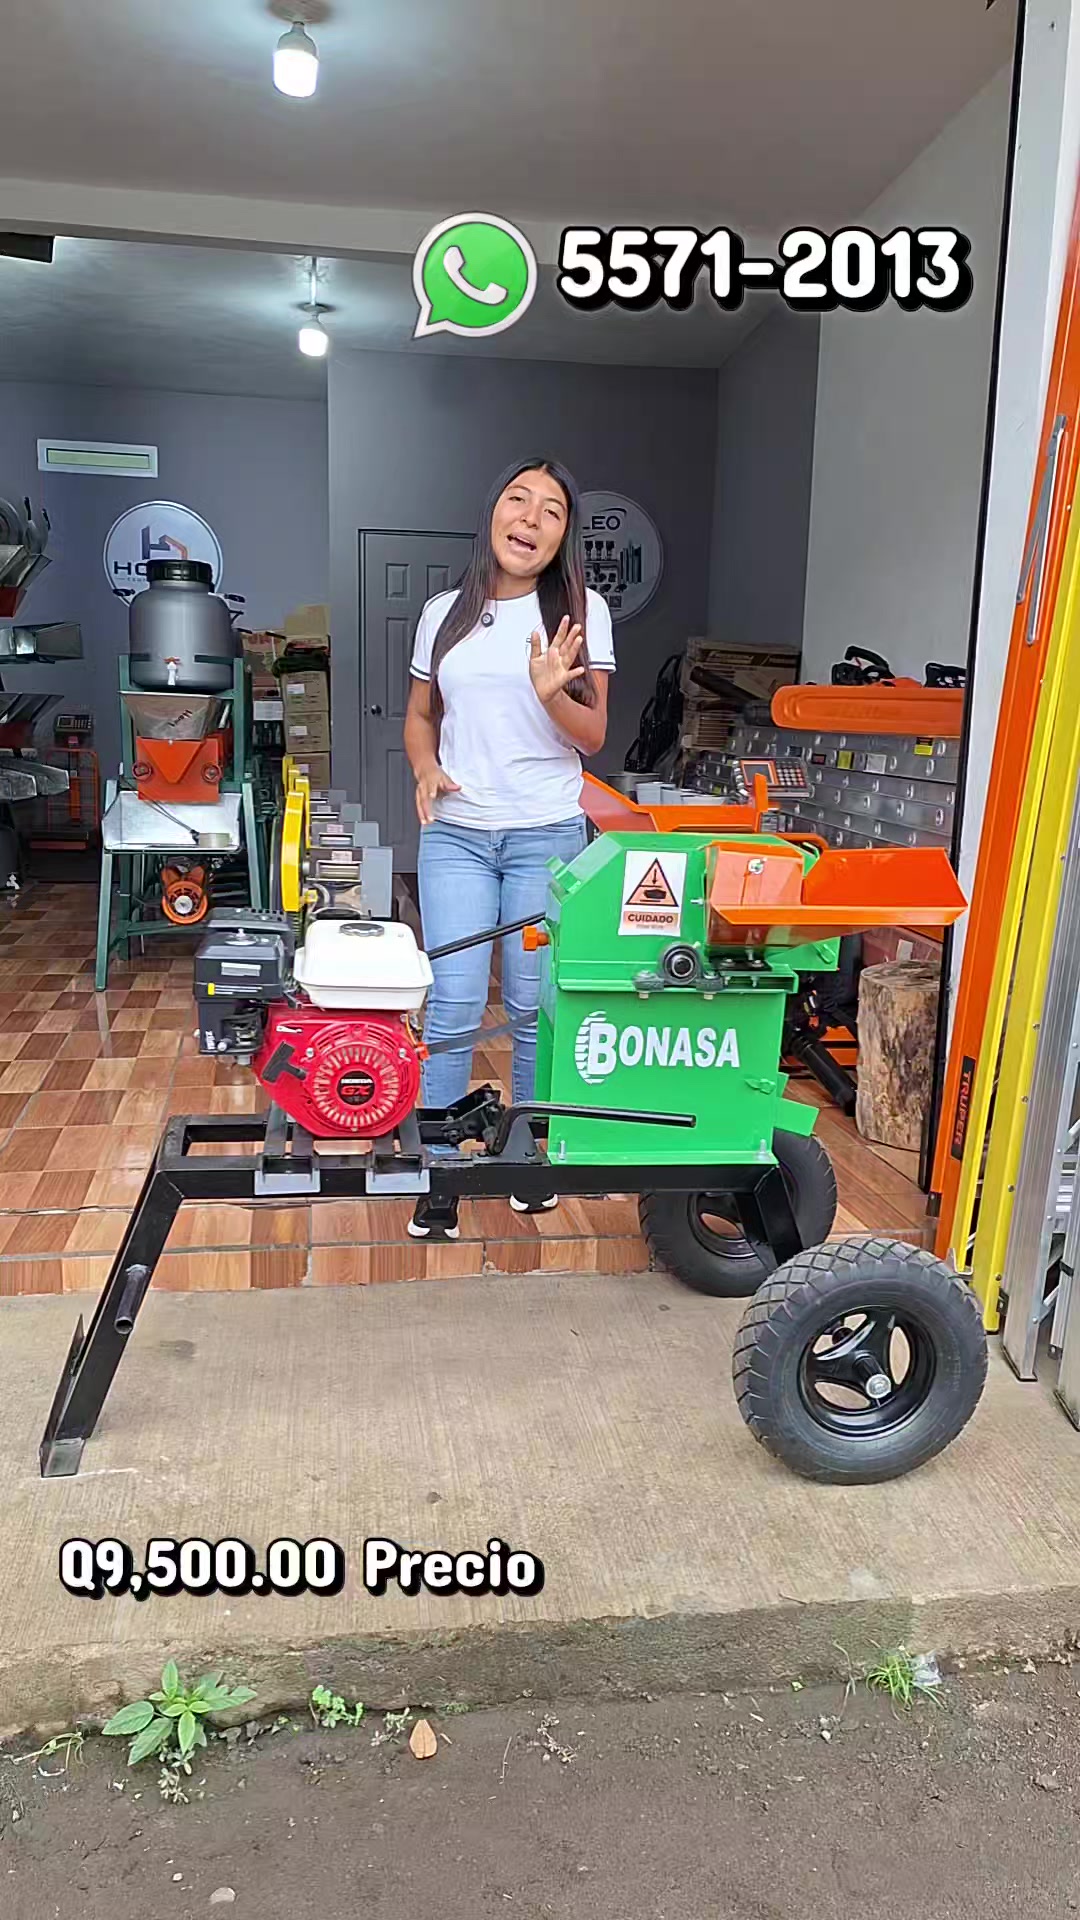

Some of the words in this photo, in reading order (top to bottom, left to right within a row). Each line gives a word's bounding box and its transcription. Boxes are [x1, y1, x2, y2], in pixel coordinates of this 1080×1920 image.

[627, 913, 674, 924] CUIDADO
[587, 1022, 741, 1076] BONASA
[954, 1071, 972, 1145] TRUPER
